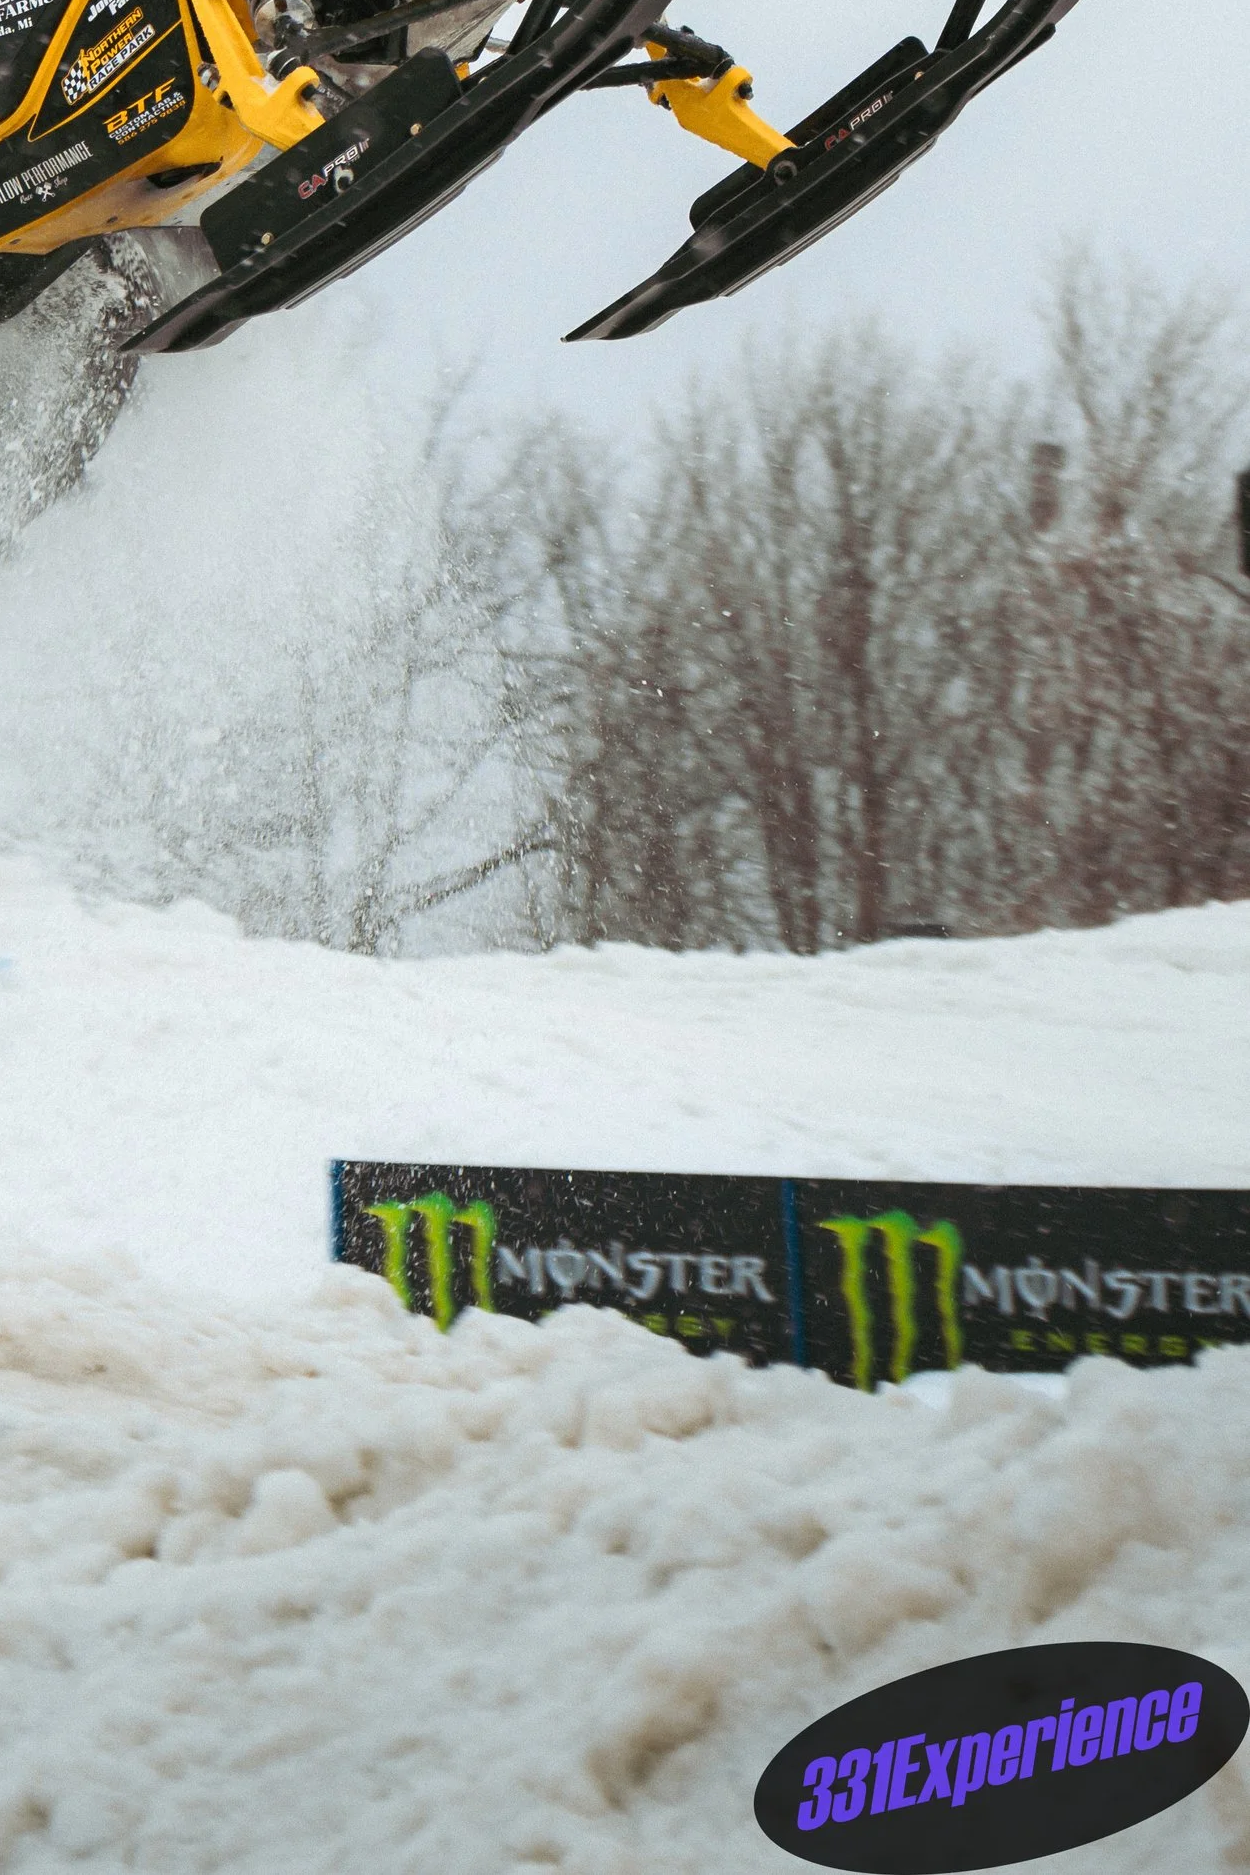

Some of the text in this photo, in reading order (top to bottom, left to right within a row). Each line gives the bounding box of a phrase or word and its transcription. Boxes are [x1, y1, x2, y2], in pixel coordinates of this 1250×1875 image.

[17, 17, 33, 31] Mi
[80, 9, 142, 67] NORTHERN
[89, 27, 152, 89] RACE PARK
[90, 32, 133, 75] POWER
[102, 77, 176, 134] BTF
[109, 110, 150, 139] CUSTOM
[151, 97, 171, 112] FAB
[115, 95, 184, 141] CONTRACTING
[20, 140, 94, 190] PERFORMANCE
[496, 1237, 776, 1303] MONSTER
